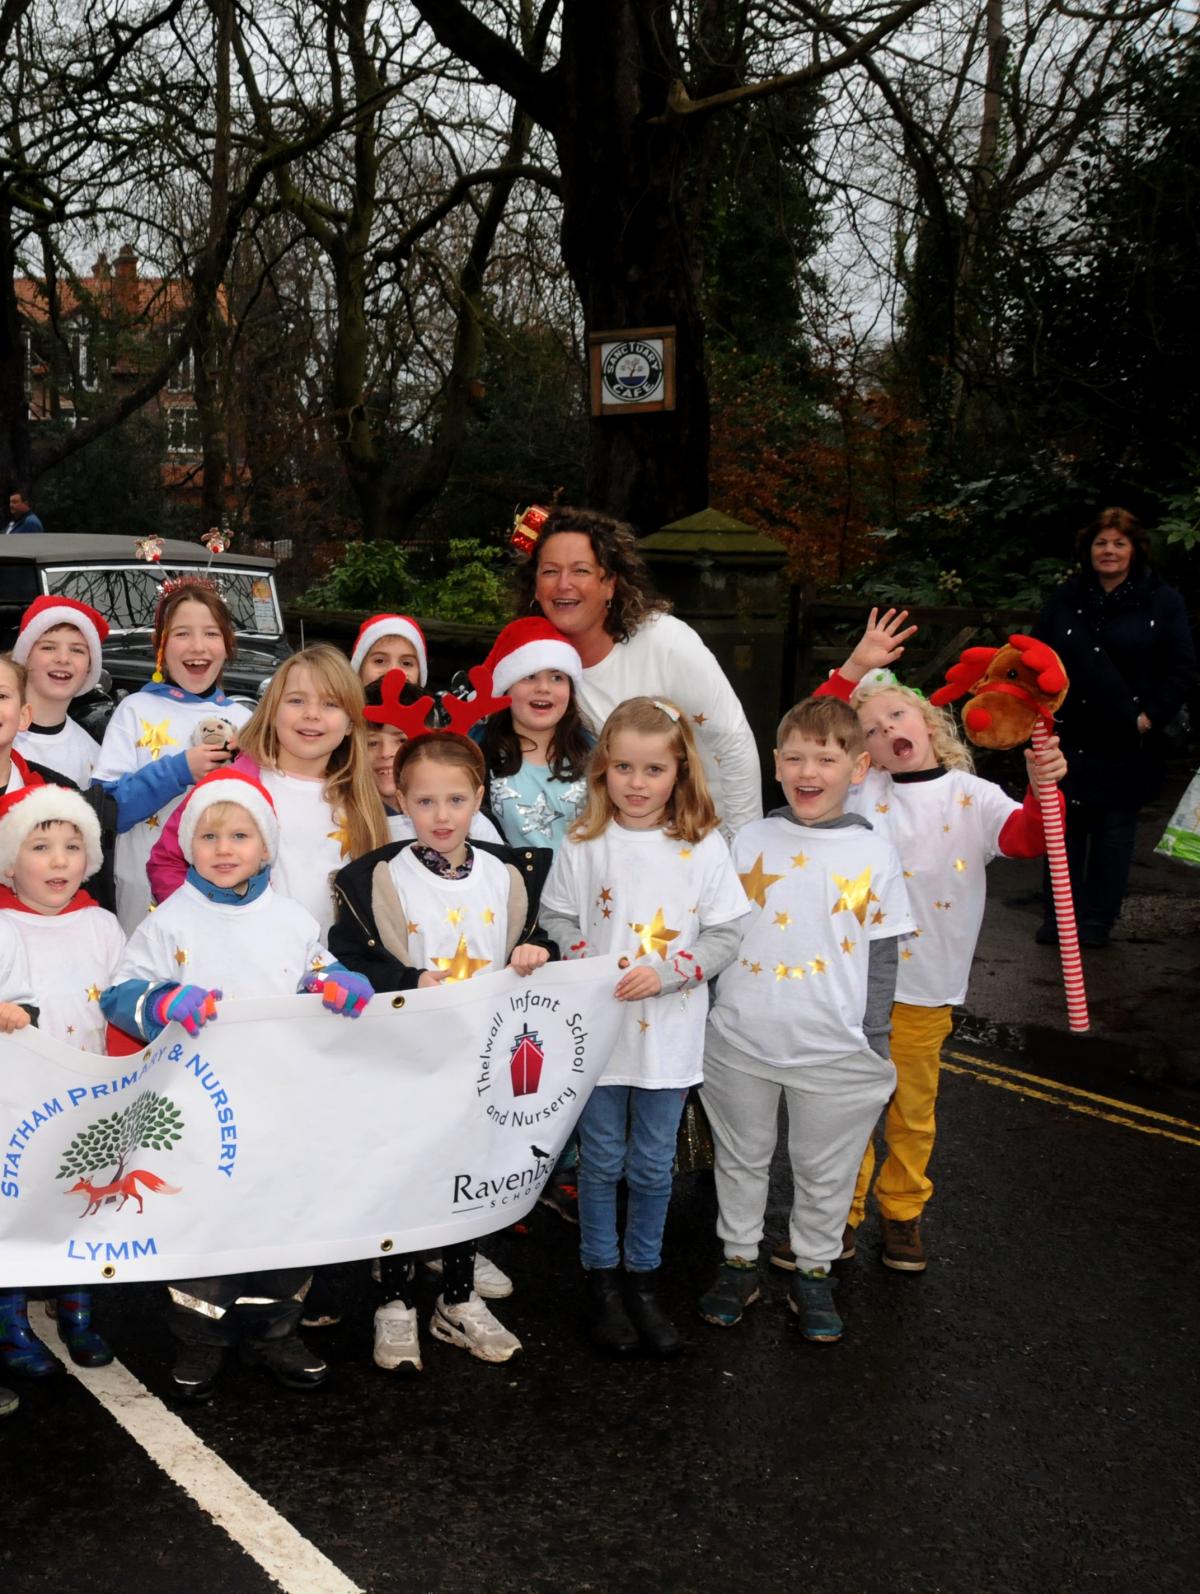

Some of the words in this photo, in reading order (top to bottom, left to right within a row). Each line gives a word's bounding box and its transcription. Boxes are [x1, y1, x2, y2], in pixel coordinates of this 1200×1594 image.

[607, 341, 659, 374] SANCTUARY
[612, 381, 654, 397] CAFE
[477, 1012, 504, 1097] Thelwall
[510, 990, 561, 1013] Infant
[566, 1012, 588, 1073] School
[1, 1097, 64, 1198] STATHAM
[167, 1043, 184, 1062] &
[184, 1053, 238, 1178] NURSERY
[486, 1104, 507, 1127] and
[511, 1087, 576, 1127] Nursery
[67, 1237, 158, 1261] LYMM
